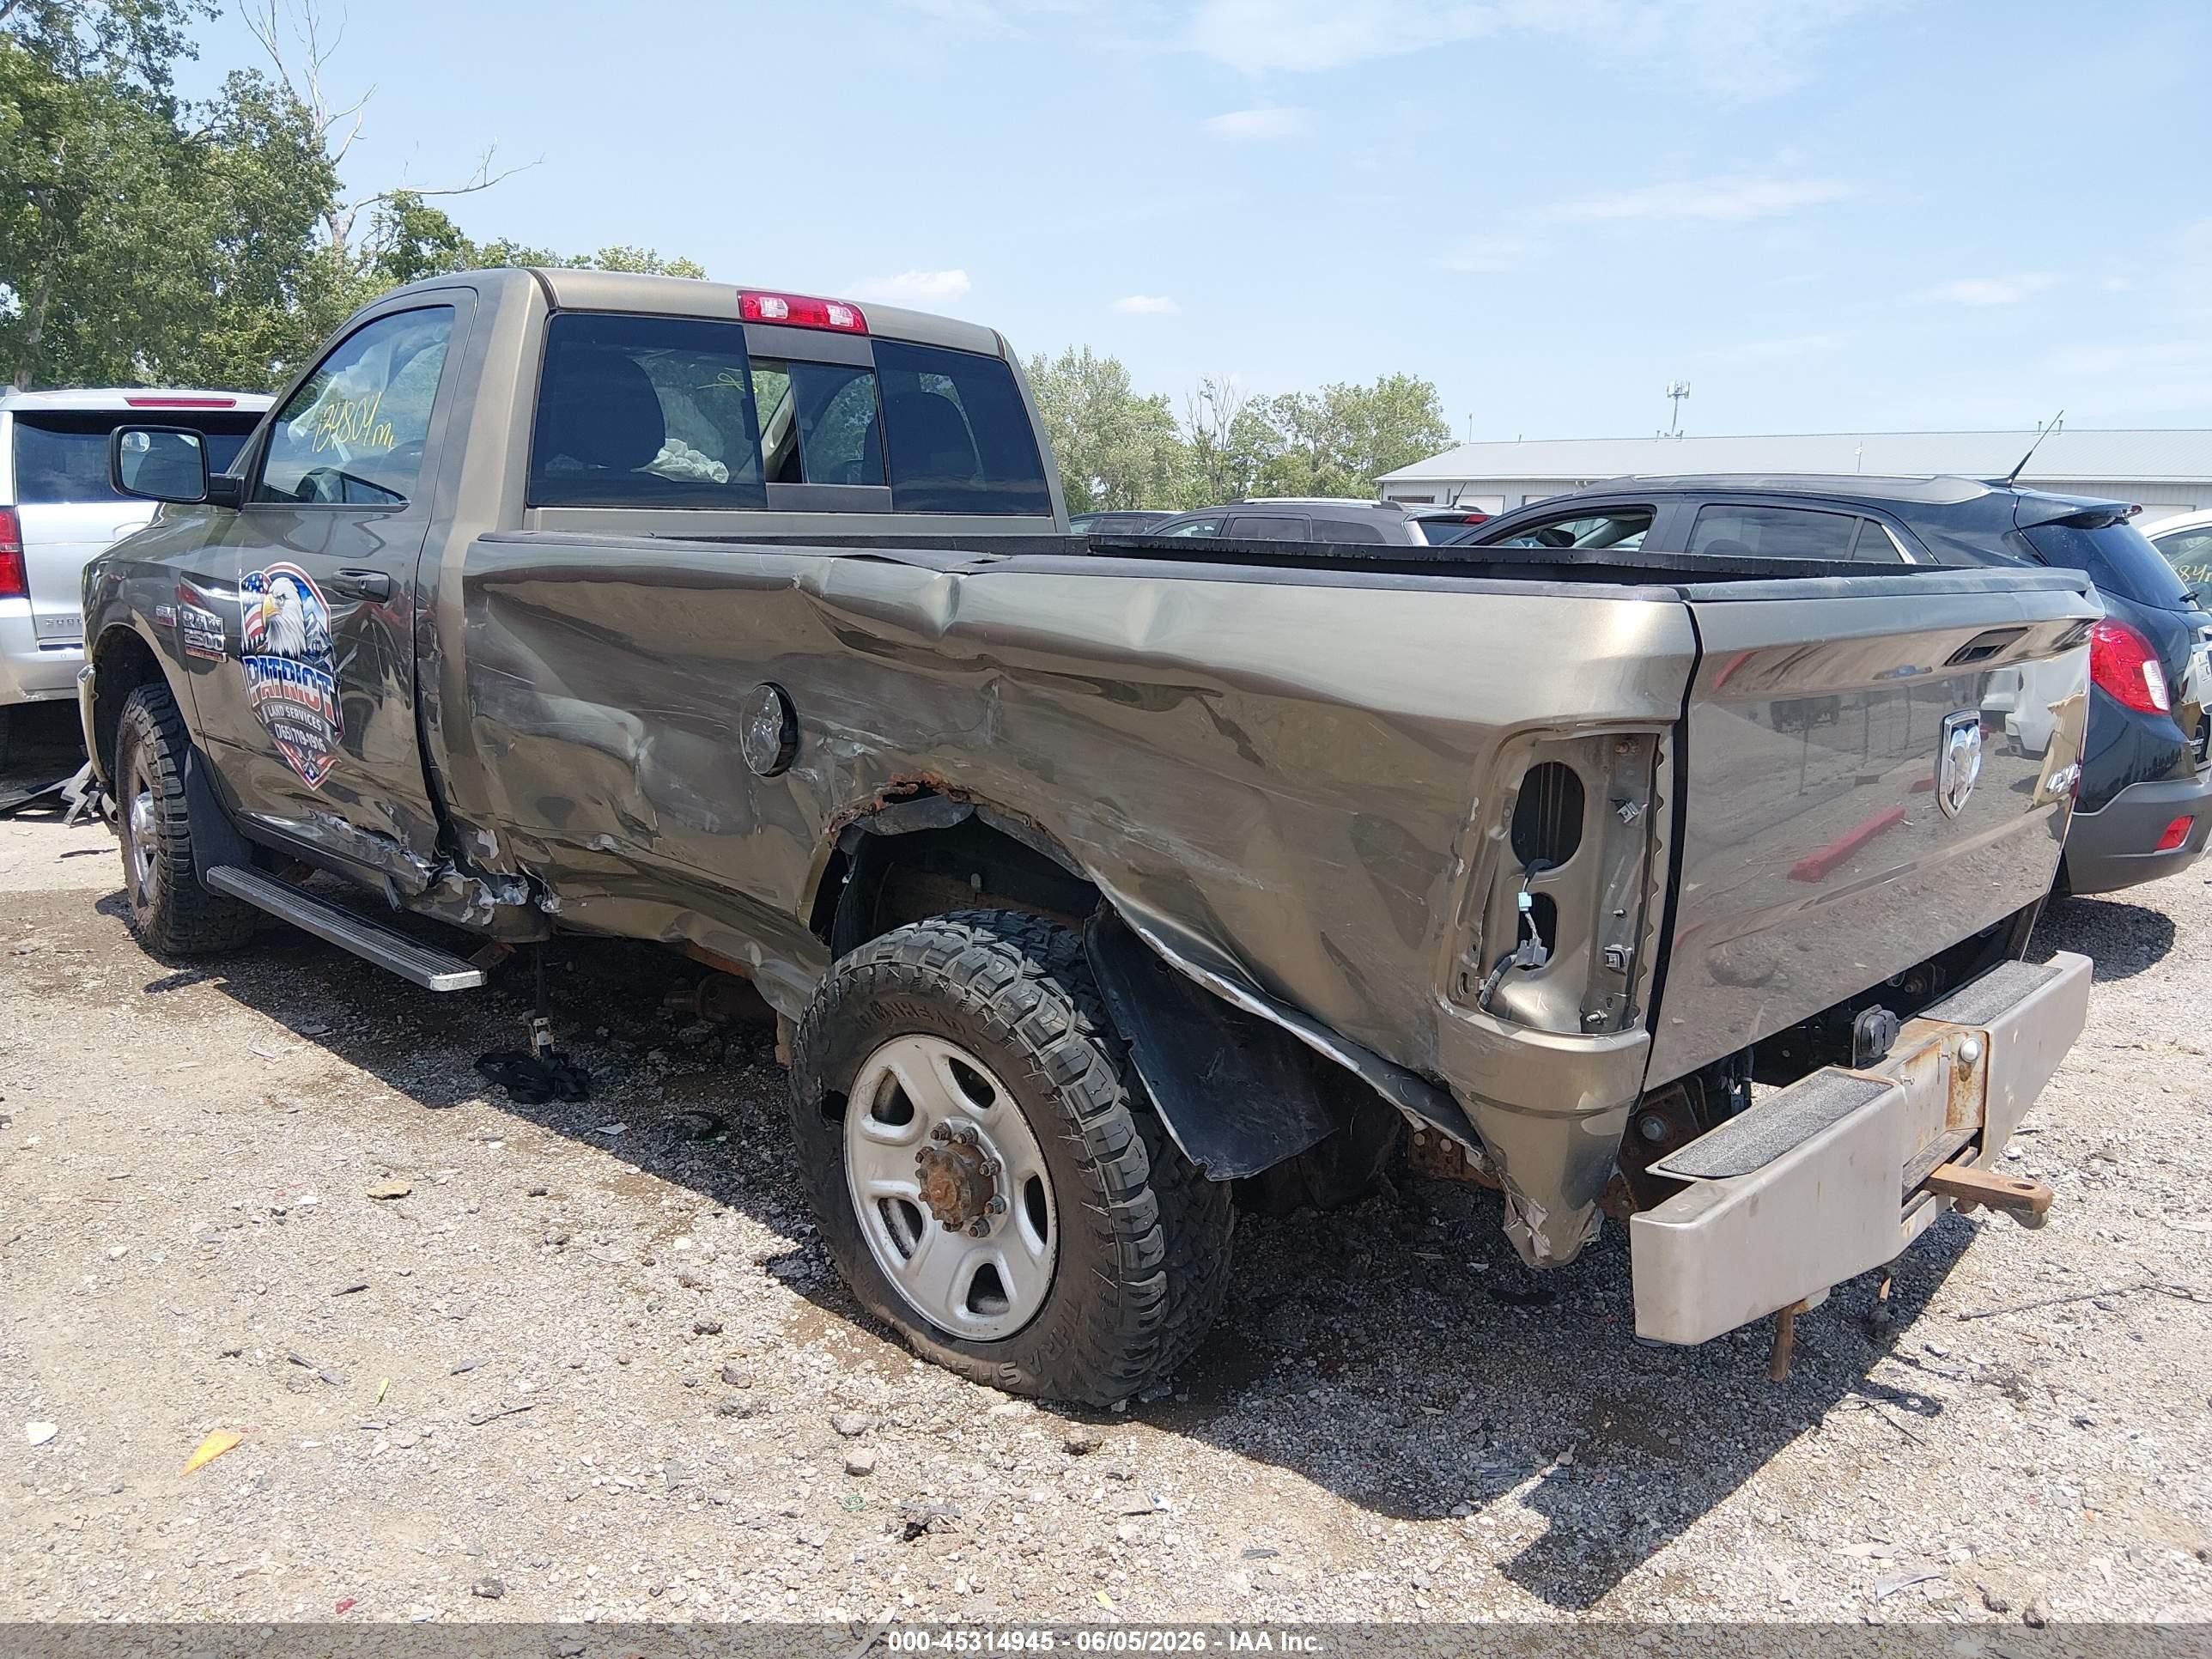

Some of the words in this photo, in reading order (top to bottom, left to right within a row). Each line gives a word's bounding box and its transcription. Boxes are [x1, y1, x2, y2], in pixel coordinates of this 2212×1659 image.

[183, 611, 224, 638] RAM
[184, 627, 226, 651] 2500
[241, 654, 337, 729] PATRIOT
[267, 706, 286, 718] LAND
[285, 706, 322, 731] SERVICES
